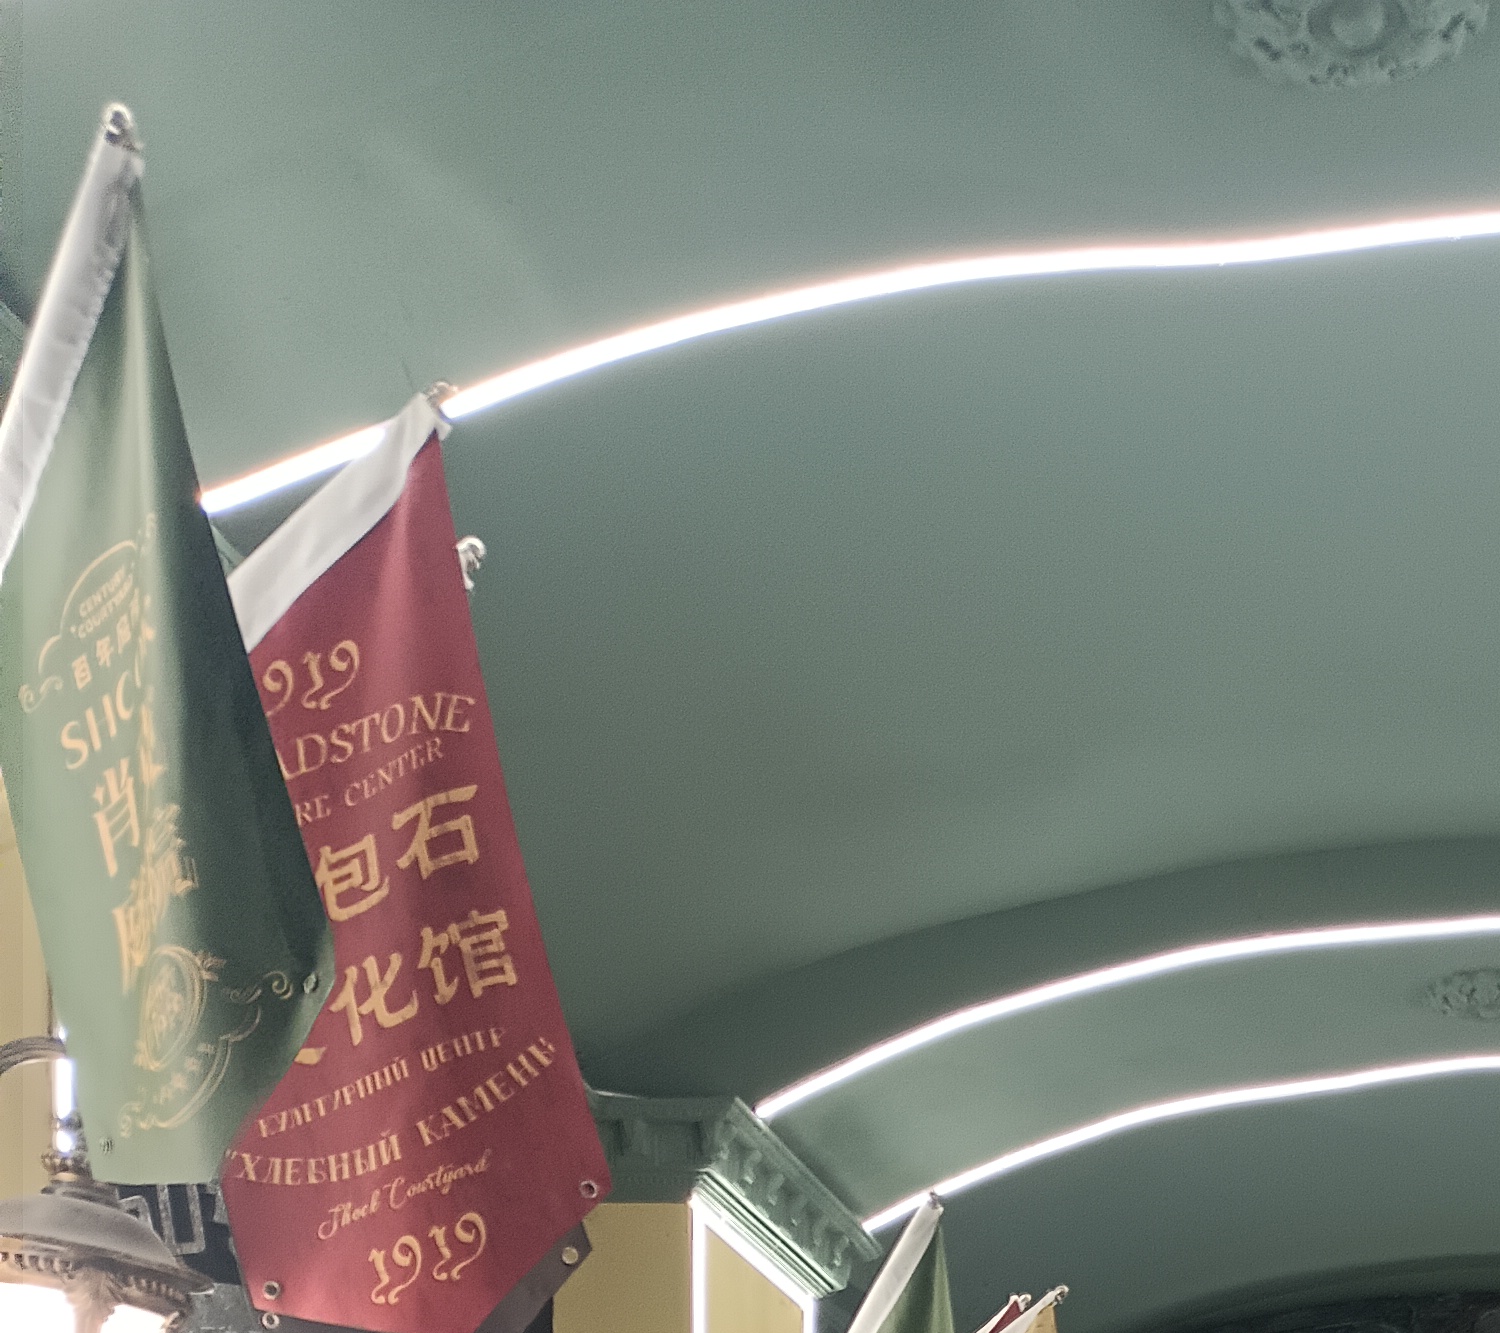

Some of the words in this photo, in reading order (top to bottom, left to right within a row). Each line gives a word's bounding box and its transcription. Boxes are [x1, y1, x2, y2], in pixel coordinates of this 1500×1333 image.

[344, 736, 444, 807] CENTER
[328, 908, 518, 1048] 化馆
[419, 1026, 506, 1072] ЦЕНТР
[367, 1211, 487, 1305] 1919
